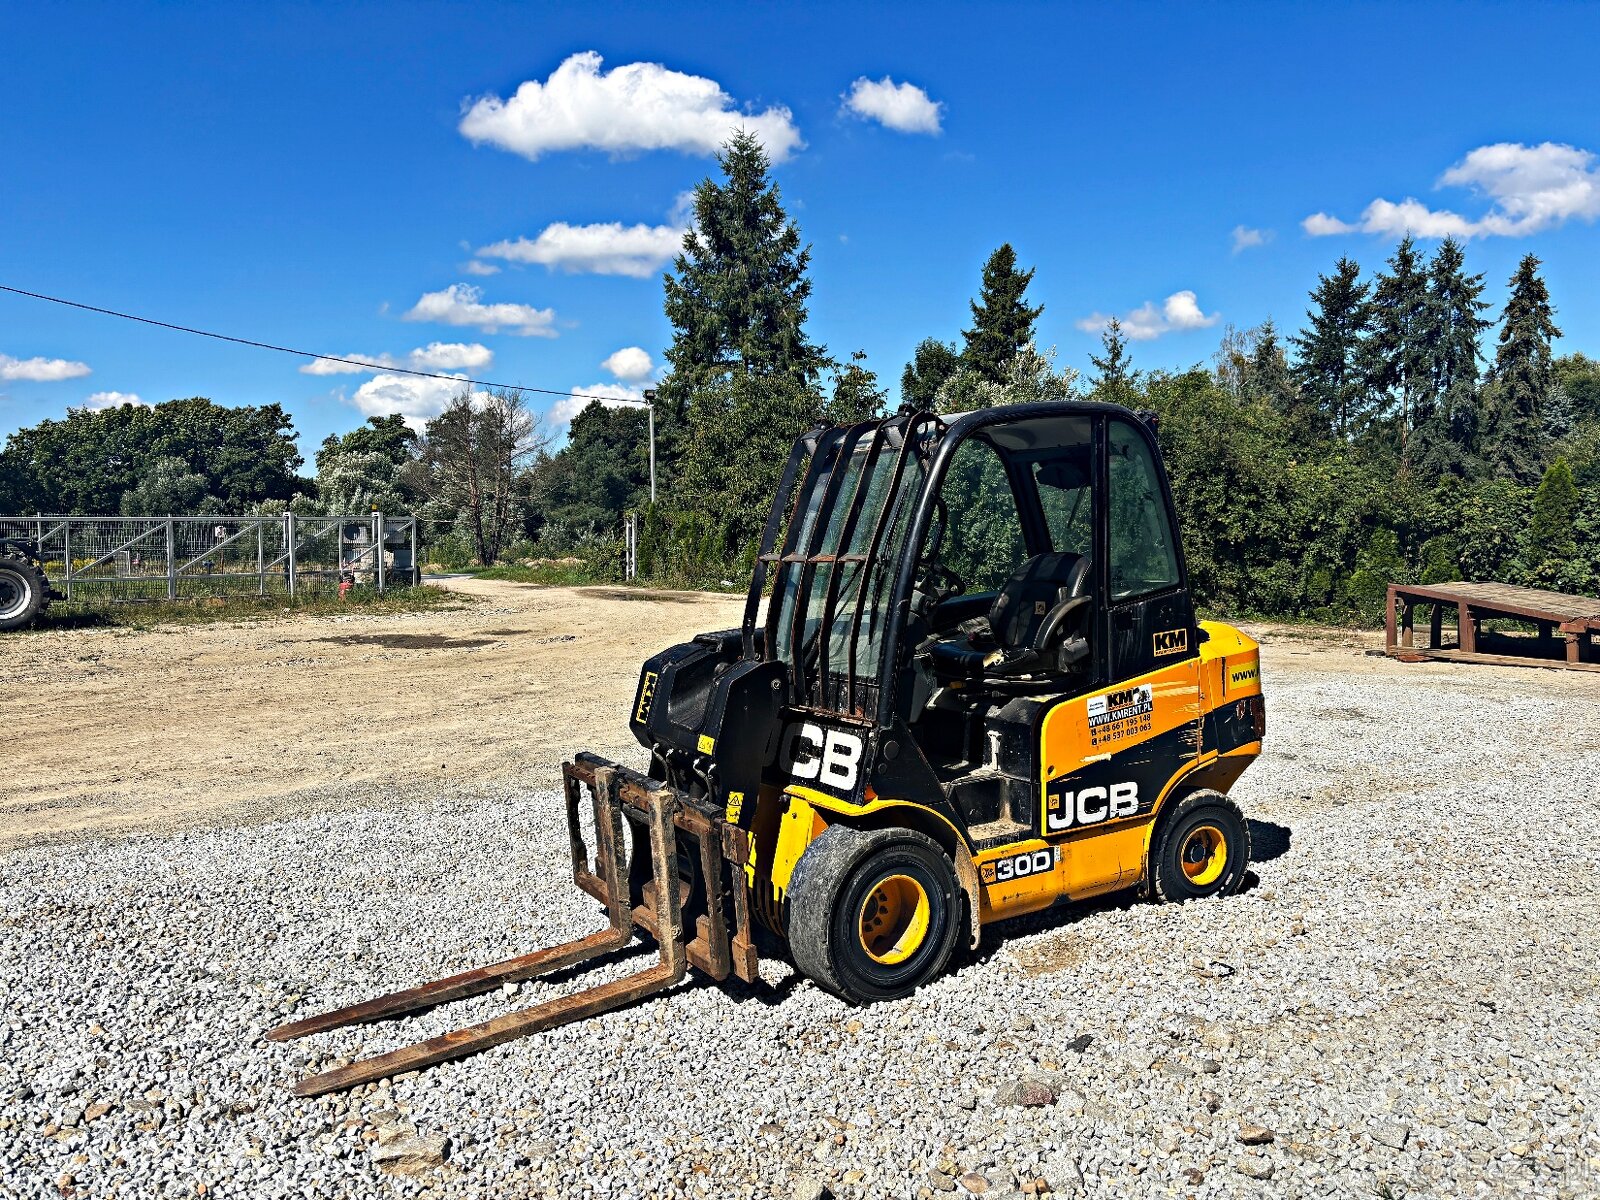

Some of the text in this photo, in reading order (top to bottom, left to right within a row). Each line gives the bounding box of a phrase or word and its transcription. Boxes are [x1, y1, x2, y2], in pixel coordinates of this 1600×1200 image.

[1155, 631, 1186, 652] KM
[639, 675, 657, 721] KM
[1107, 690, 1134, 707] KM
[1088, 703, 1153, 727] WWW.KMRENT.PL
[1098, 713, 1151, 735] +48 661 195 148
[1098, 734, 1111, 744] +48
[1126, 726, 1139, 736] 003
[1139, 722, 1152, 732] 063
[1048, 781, 1139, 830] JCB
[997, 851, 1051, 880] 30D
